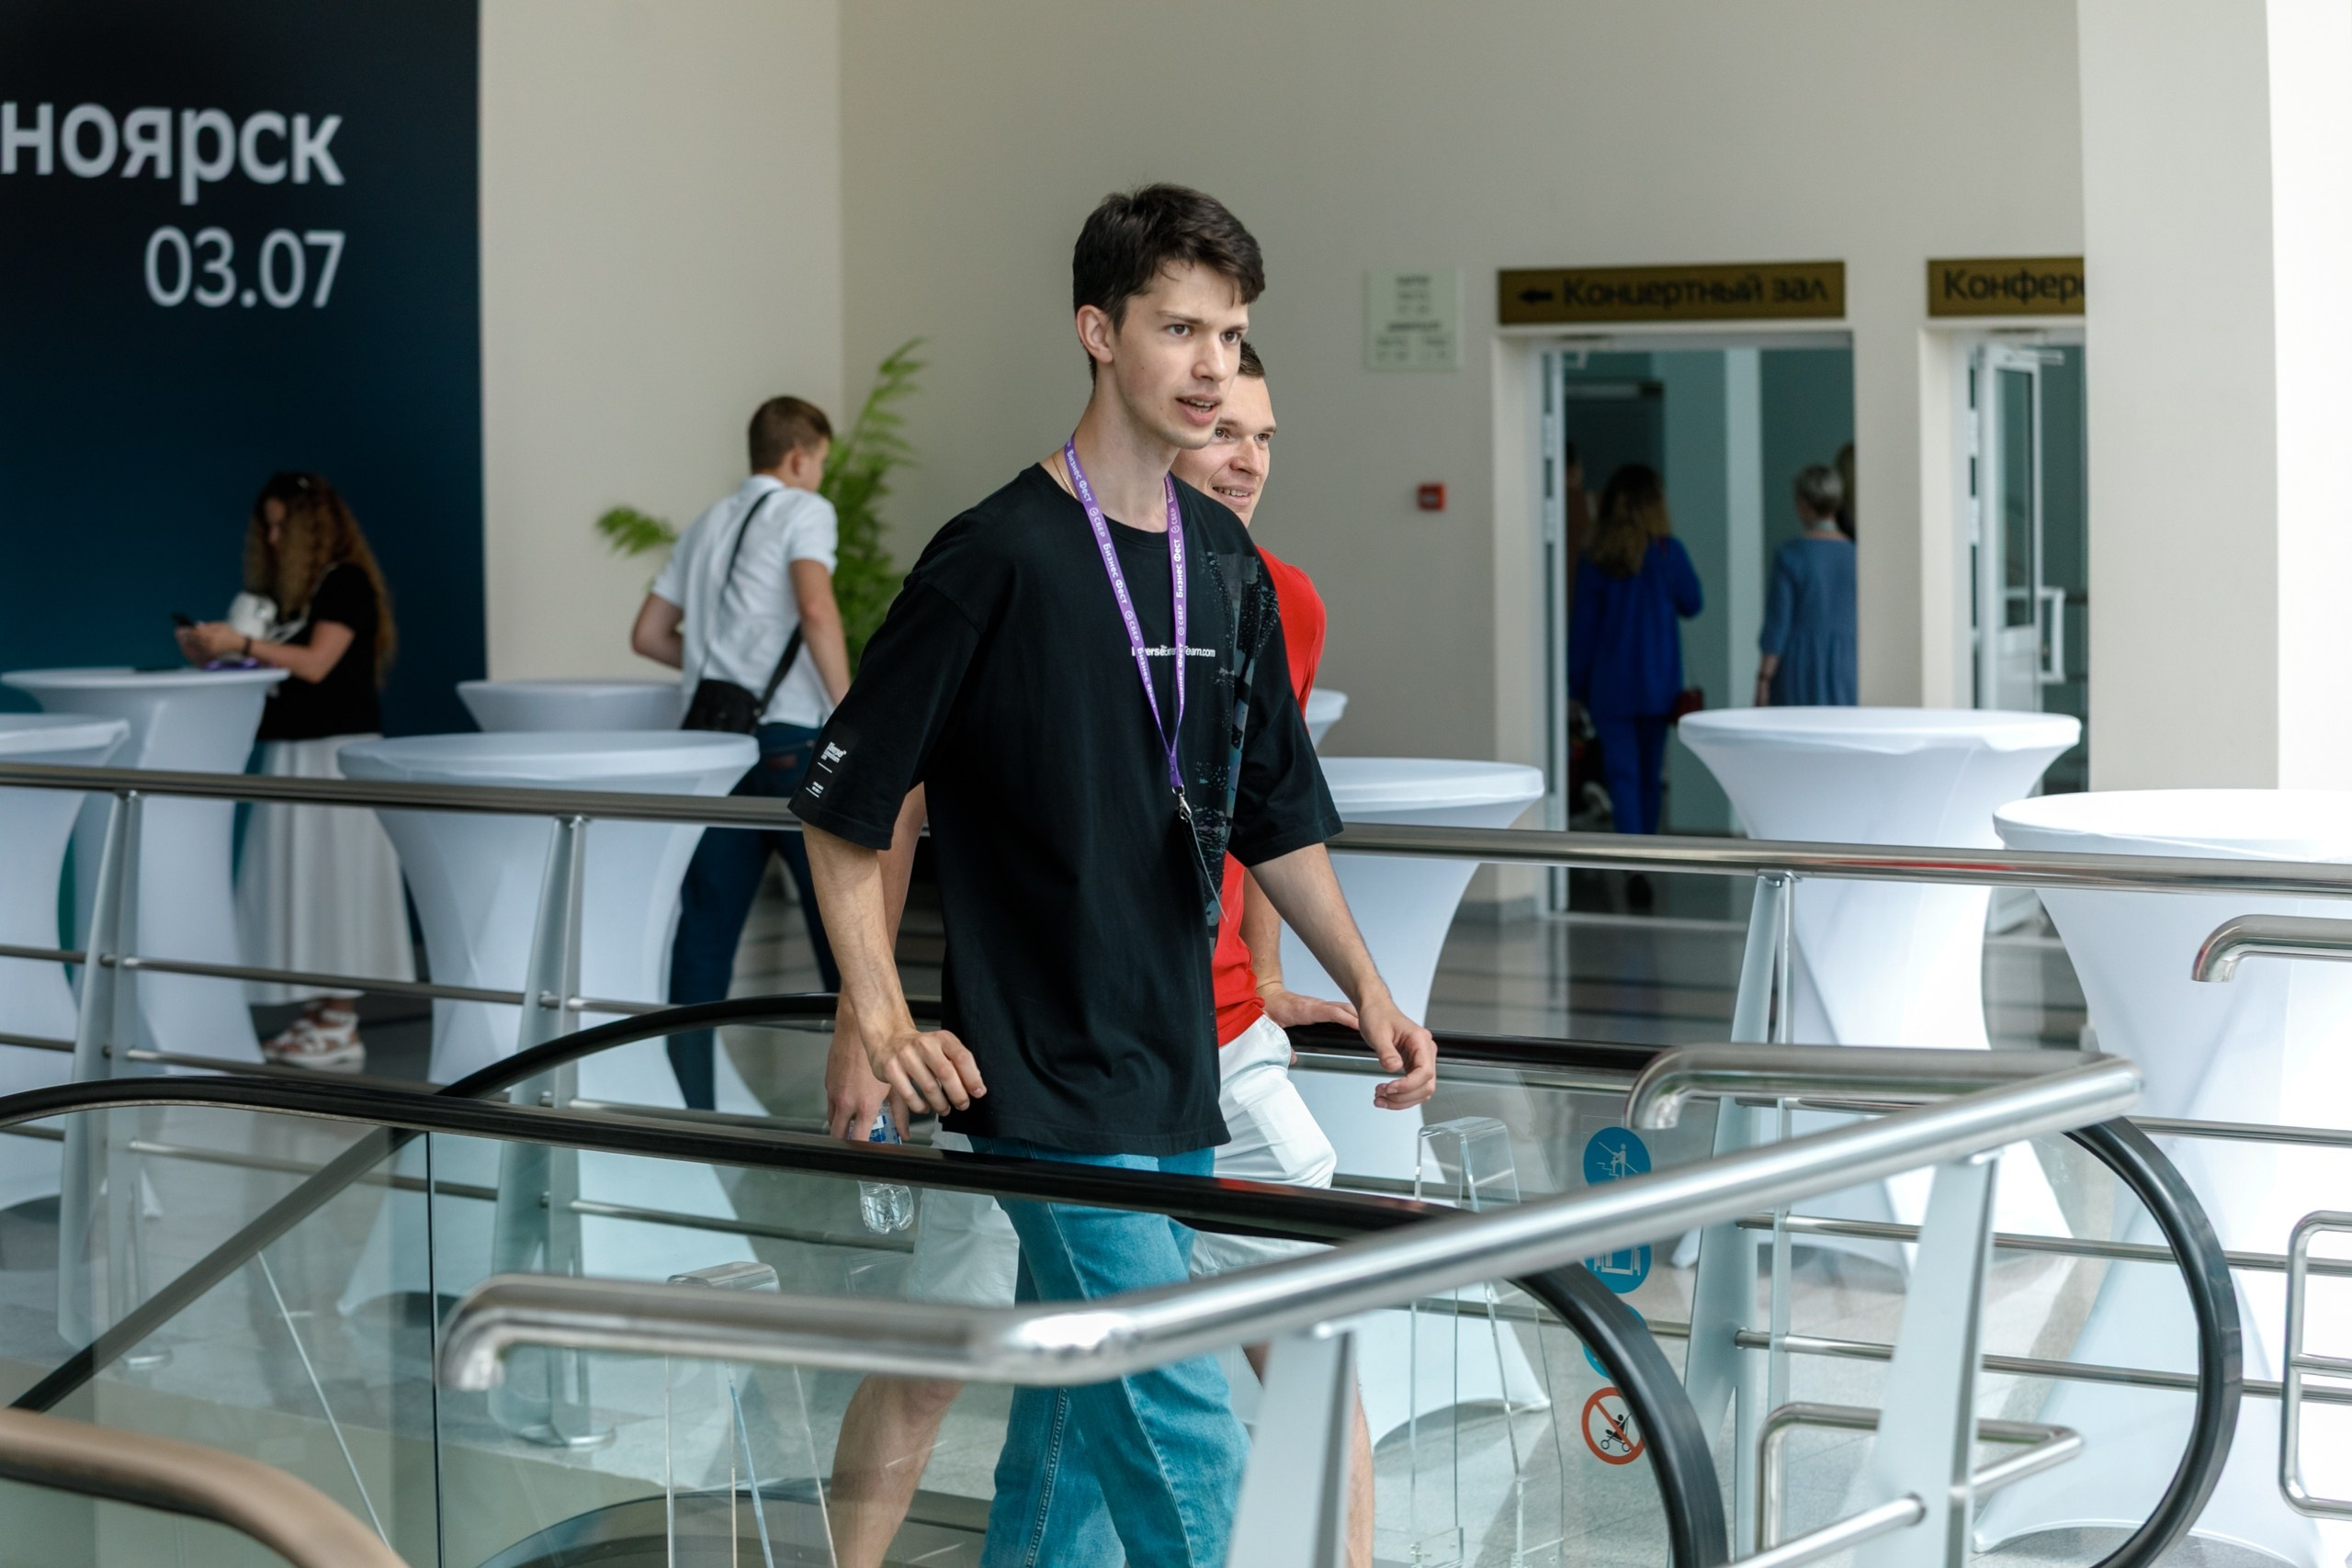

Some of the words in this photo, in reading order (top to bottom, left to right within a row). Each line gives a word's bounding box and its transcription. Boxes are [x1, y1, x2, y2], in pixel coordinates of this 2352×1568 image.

[1, 101, 345, 205] ноярск
[144, 225, 345, 308] 03.07
[1564, 274, 1763, 310] Концертный
[1774, 277, 1829, 302] зал
[1067, 449, 1082, 480] Бизнес
[1080, 479, 1092, 502] Фест
[1102, 543, 1119, 578] Бизнес
[1115, 579, 1127, 604] Фест
[1129, 621, 1139, 641] СБЕР
[1137, 648, 1148, 682] Бизнес
[1173, 539, 1182, 562] Фест
